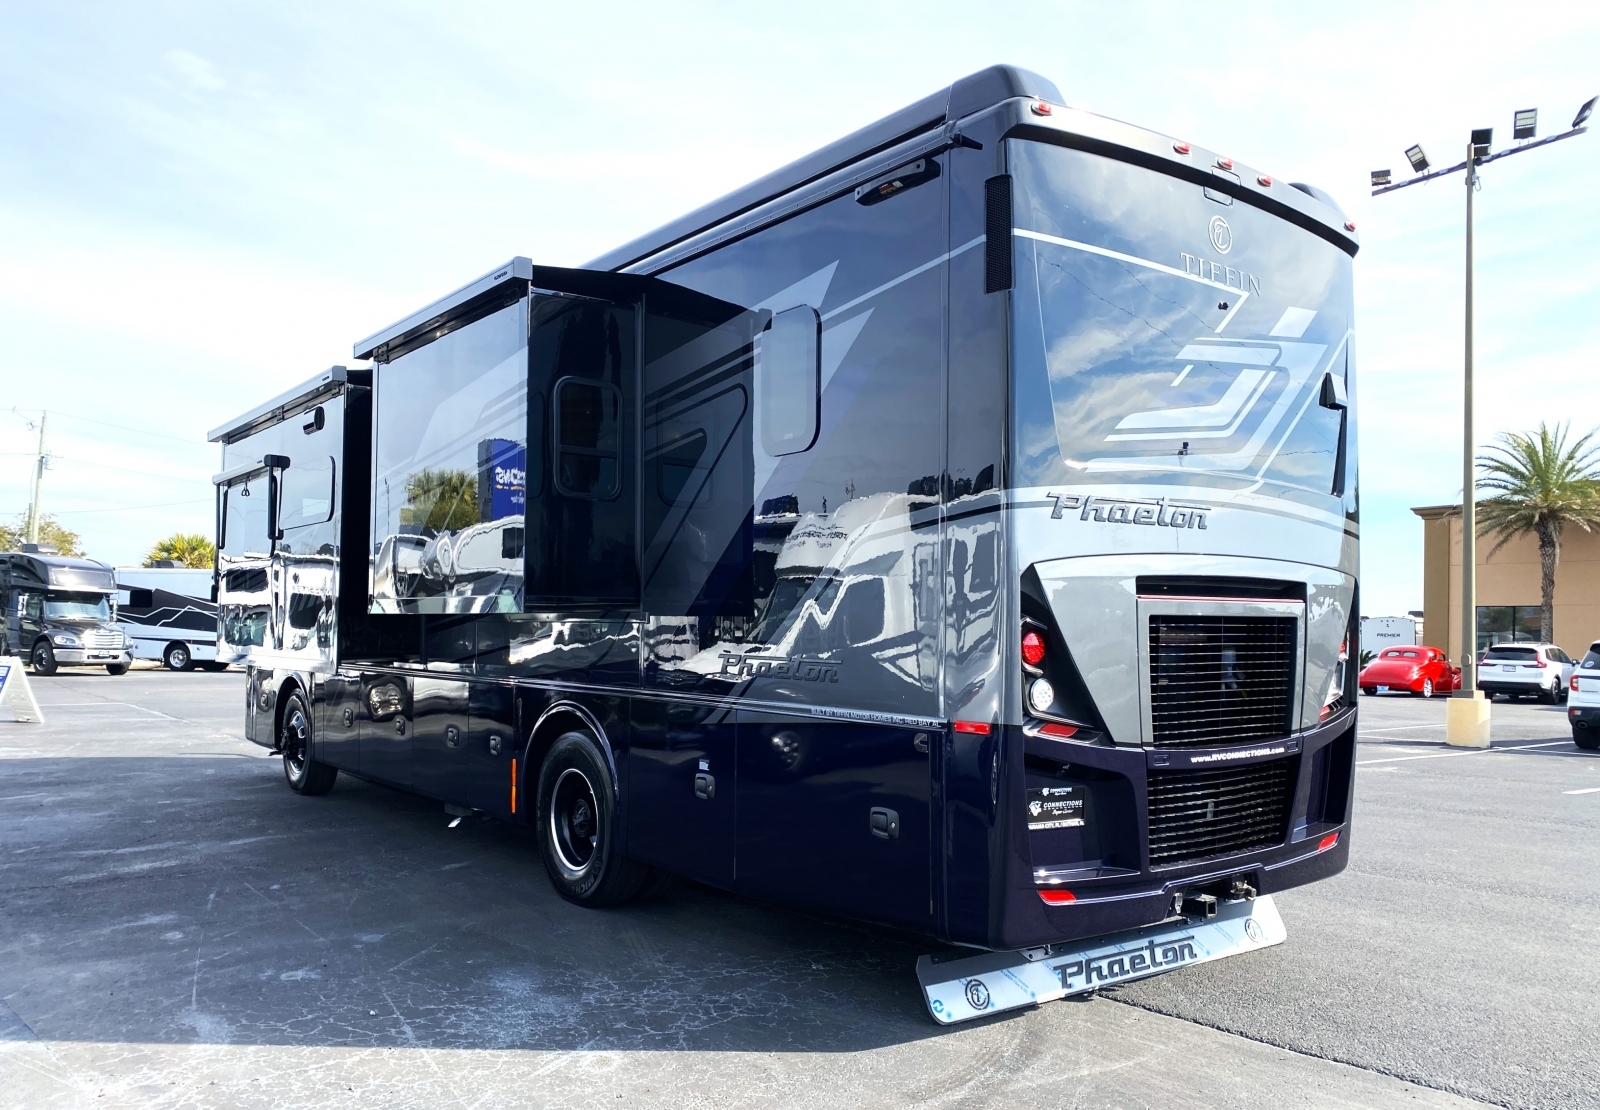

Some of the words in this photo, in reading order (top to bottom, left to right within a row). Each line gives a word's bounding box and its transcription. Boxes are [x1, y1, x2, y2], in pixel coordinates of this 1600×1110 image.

[1180, 252, 1261, 297] TIFFIN
[1046, 491, 1212, 530] Phaeton
[718, 653, 843, 684] Phaeton
[1191, 747, 1285, 763] www.RVCONNECTIONS.com
[1043, 800, 1083, 808] CONNECTIONS
[1053, 935, 1198, 990] Phaeton
